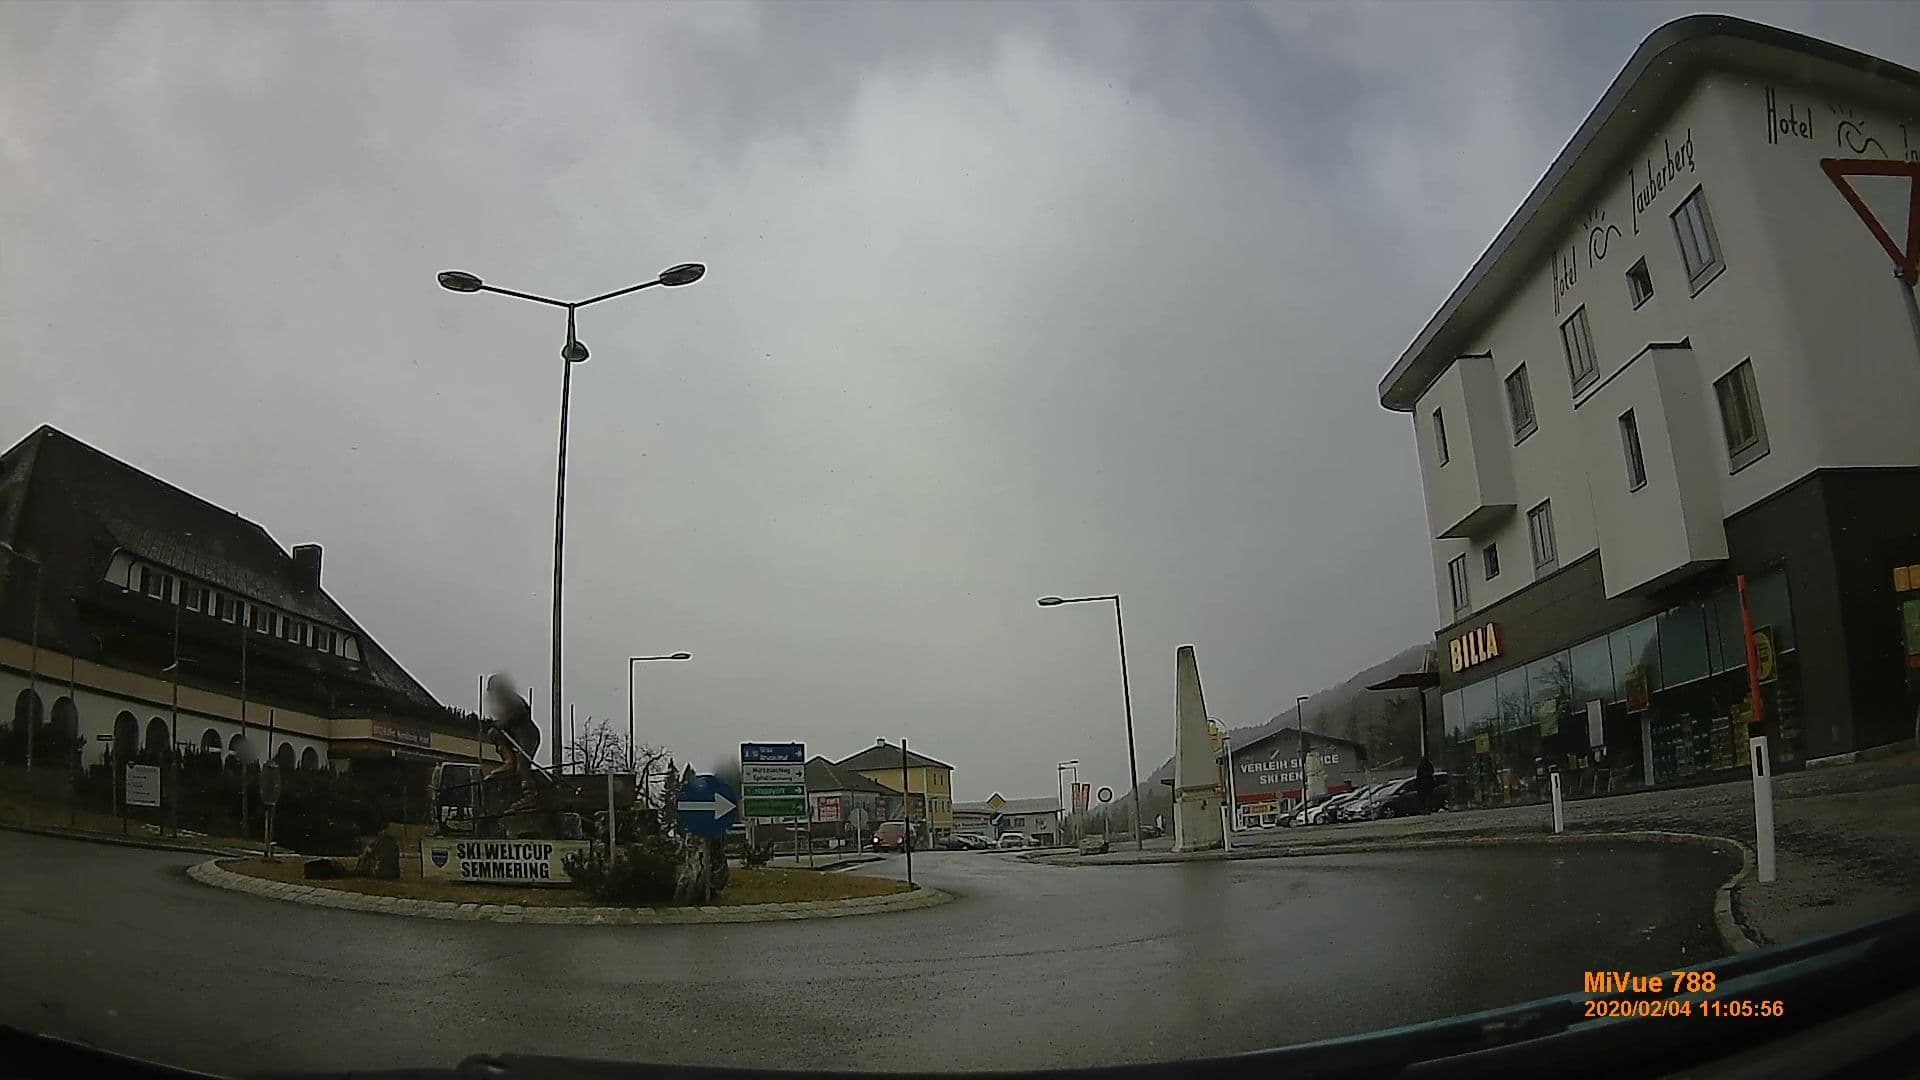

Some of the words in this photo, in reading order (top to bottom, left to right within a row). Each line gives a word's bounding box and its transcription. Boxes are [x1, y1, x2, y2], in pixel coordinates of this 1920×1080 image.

[1766, 84, 1813, 144] Hotel
[1552, 244, 1577, 316] Hotel
[1628, 128, 1695, 236] Zauberberg
[1450, 622, 1499, 673] BILLA
[1241, 759, 1288, 774] VERLEIH
[1260, 772, 1279, 785] SKI
[457, 843, 482, 860] SKI
[485, 843, 553, 861] WELTCUP
[461, 861, 549, 879] SEMMERING
